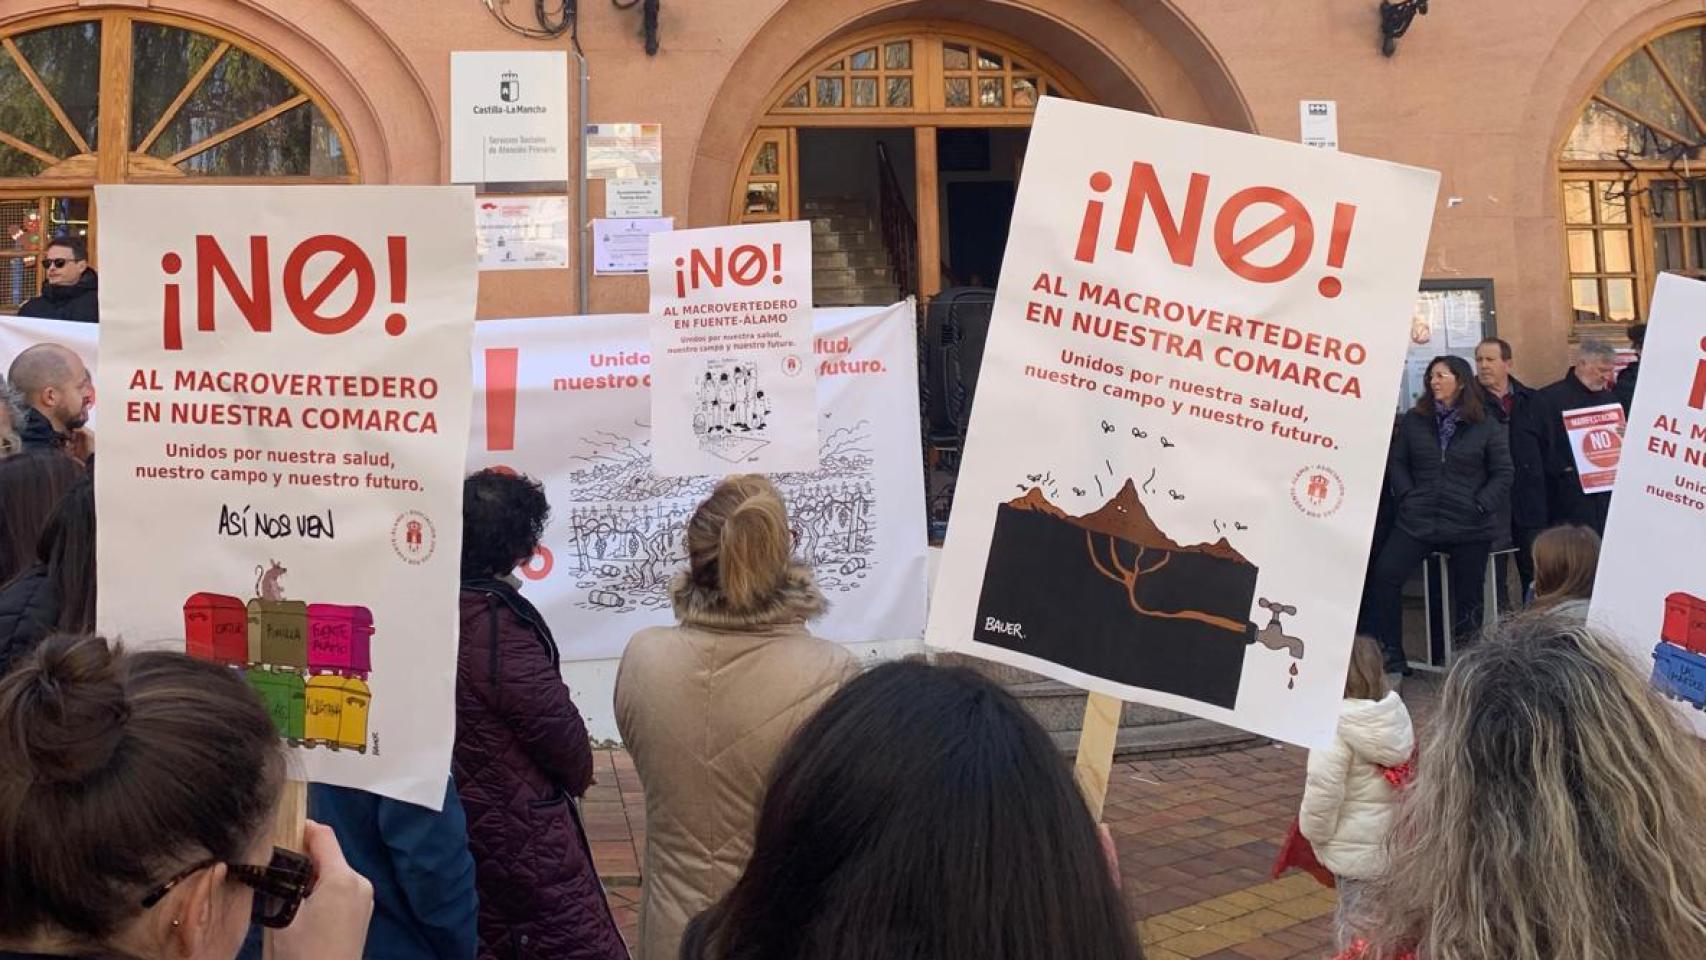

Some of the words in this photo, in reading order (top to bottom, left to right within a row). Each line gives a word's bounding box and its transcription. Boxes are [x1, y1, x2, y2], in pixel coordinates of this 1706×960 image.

[516, 105, 547, 114] Mancha
[1073, 159, 1359, 300] ¡NO!
[674, 240, 784, 299] ¡NO!
[160, 233, 409, 353] ¡NO!
[663, 306, 679, 317] AL
[682, 299, 798, 315] MACROVERTEDERO
[1031, 271, 1069, 299] AL
[1077, 280, 1368, 366] MACROVERTEDERO
[673, 319, 690, 330] EN
[666, 346, 698, 354] nuestro
[699, 343, 725, 353] campo
[726, 342, 733, 352] y
[733, 341, 766, 351] nuestro
[767, 339, 797, 349] futuro.
[680, 335, 706, 344] Unidos
[707, 335, 721, 343] por
[723, 332, 754, 342] nuestra
[1024, 300, 1066, 328] EN
[1070, 311, 1204, 361] NUESTRA
[1212, 345, 1363, 399] COMARCA
[589, 351, 651, 367] Unido
[820, 360, 887, 377] futuro.
[129, 368, 163, 393] AL
[173, 368, 439, 401] MACROVERTEDERO
[553, 373, 638, 391] nuestro
[1060, 349, 1125, 377] Unidos
[1129, 368, 1164, 386] por
[1168, 377, 1244, 406] nuestra
[1249, 396, 1309, 423] salud,
[126, 399, 162, 424] EN
[170, 401, 293, 430] NUESTRA
[301, 406, 438, 435] COMARCA
[1024, 364, 1097, 392] nuestro
[1102, 383, 1166, 408] campo
[1171, 400, 1184, 416] y
[1189, 405, 1265, 432] nuestro
[1271, 421, 1339, 451] futuro.
[1653, 414, 1682, 436] AL
[1590, 430, 1612, 451] NO
[1647, 435, 1678, 459] EN
[165, 443, 228, 460] Unidos
[233, 447, 262, 463] por
[266, 449, 337, 465] nuestra
[342, 451, 396, 470] salud,
[135, 464, 205, 480] nuestro
[210, 468, 268, 485] campo
[272, 471, 283, 488] y
[288, 471, 360, 488] nuestro
[365, 472, 425, 492] futuro.
[1646, 485, 1706, 511] nuestro
[254, 511, 292, 540] NOS
[296, 508, 334, 539] VEN
[984, 616, 1027, 640] BAUER.
